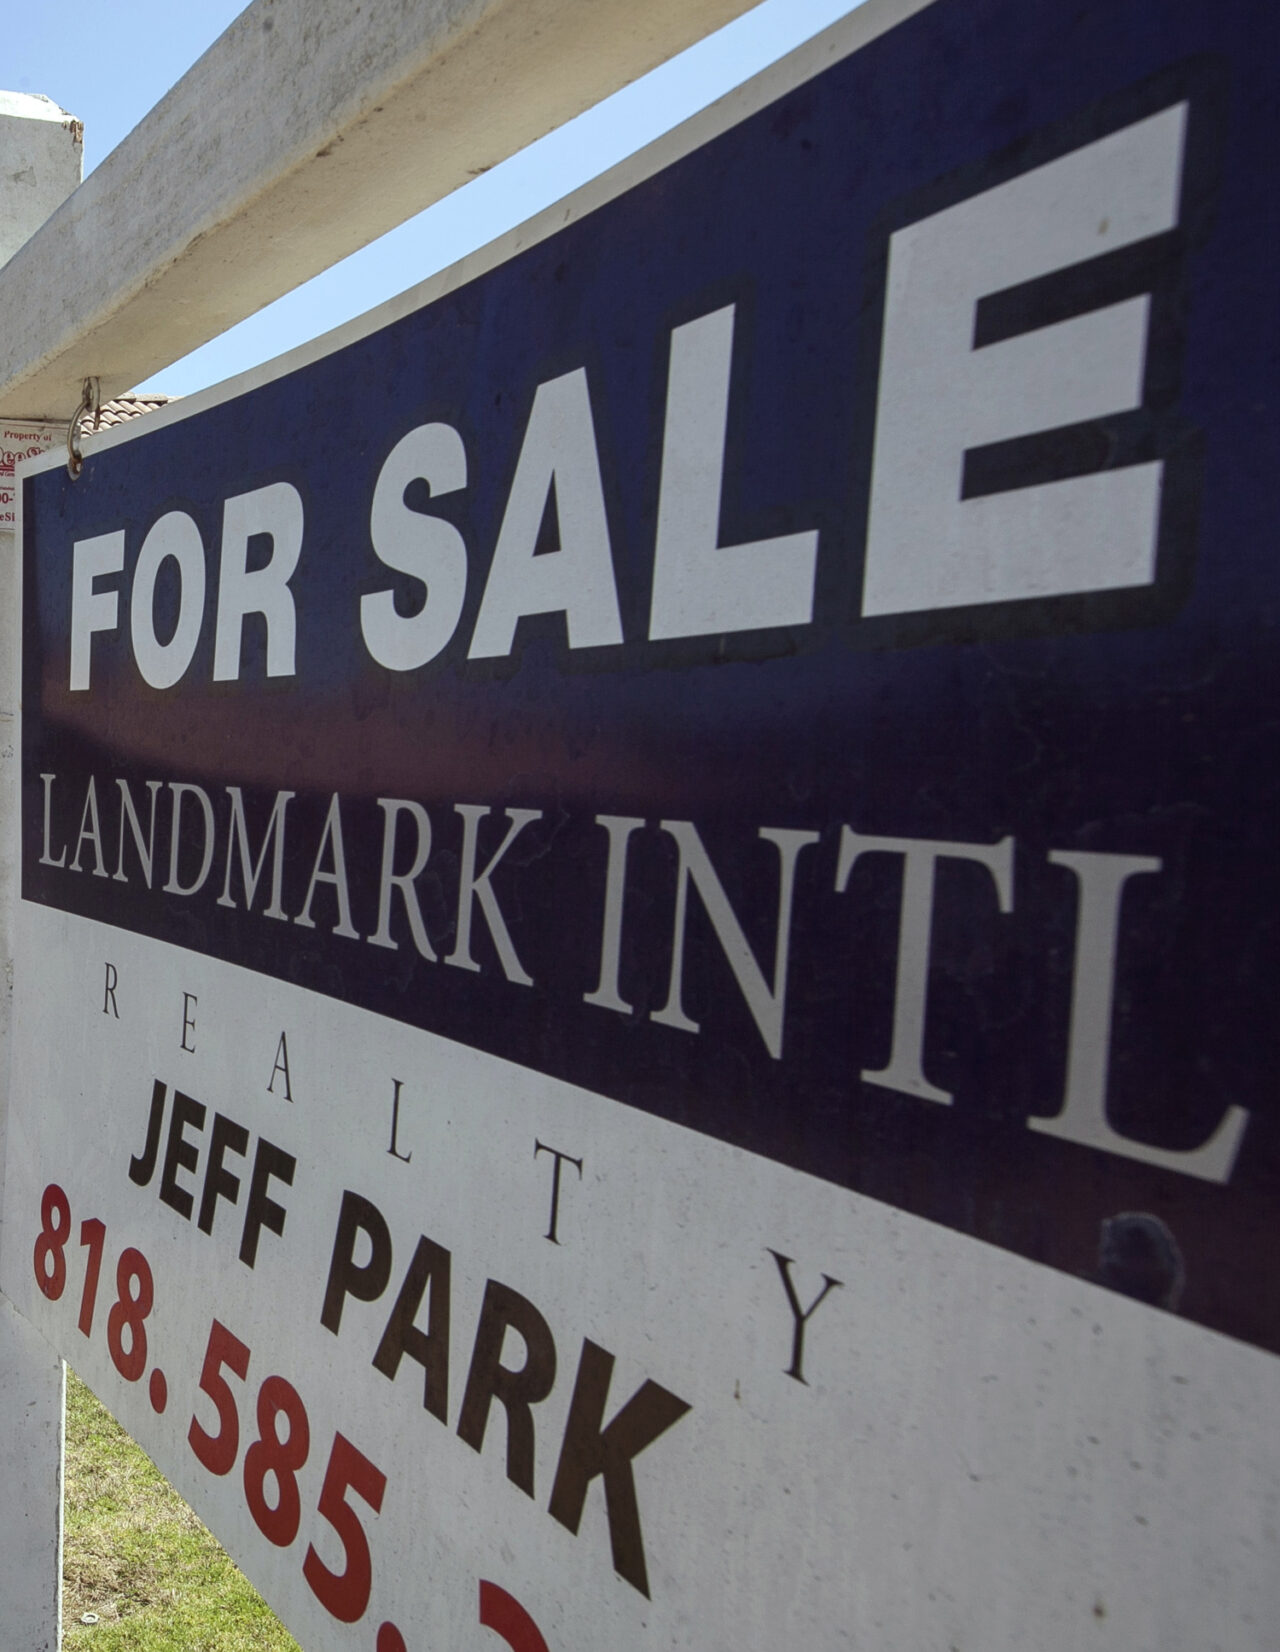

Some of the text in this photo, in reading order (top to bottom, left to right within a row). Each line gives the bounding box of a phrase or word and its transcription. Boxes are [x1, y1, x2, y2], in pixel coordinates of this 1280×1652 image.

[4, 430, 52, 442] Property of
[69, 99, 1189, 692] FOR SALE
[38, 772, 1251, 1185] LANDMARK INTL
[128, 1079, 692, 1601] JEFF PARK
